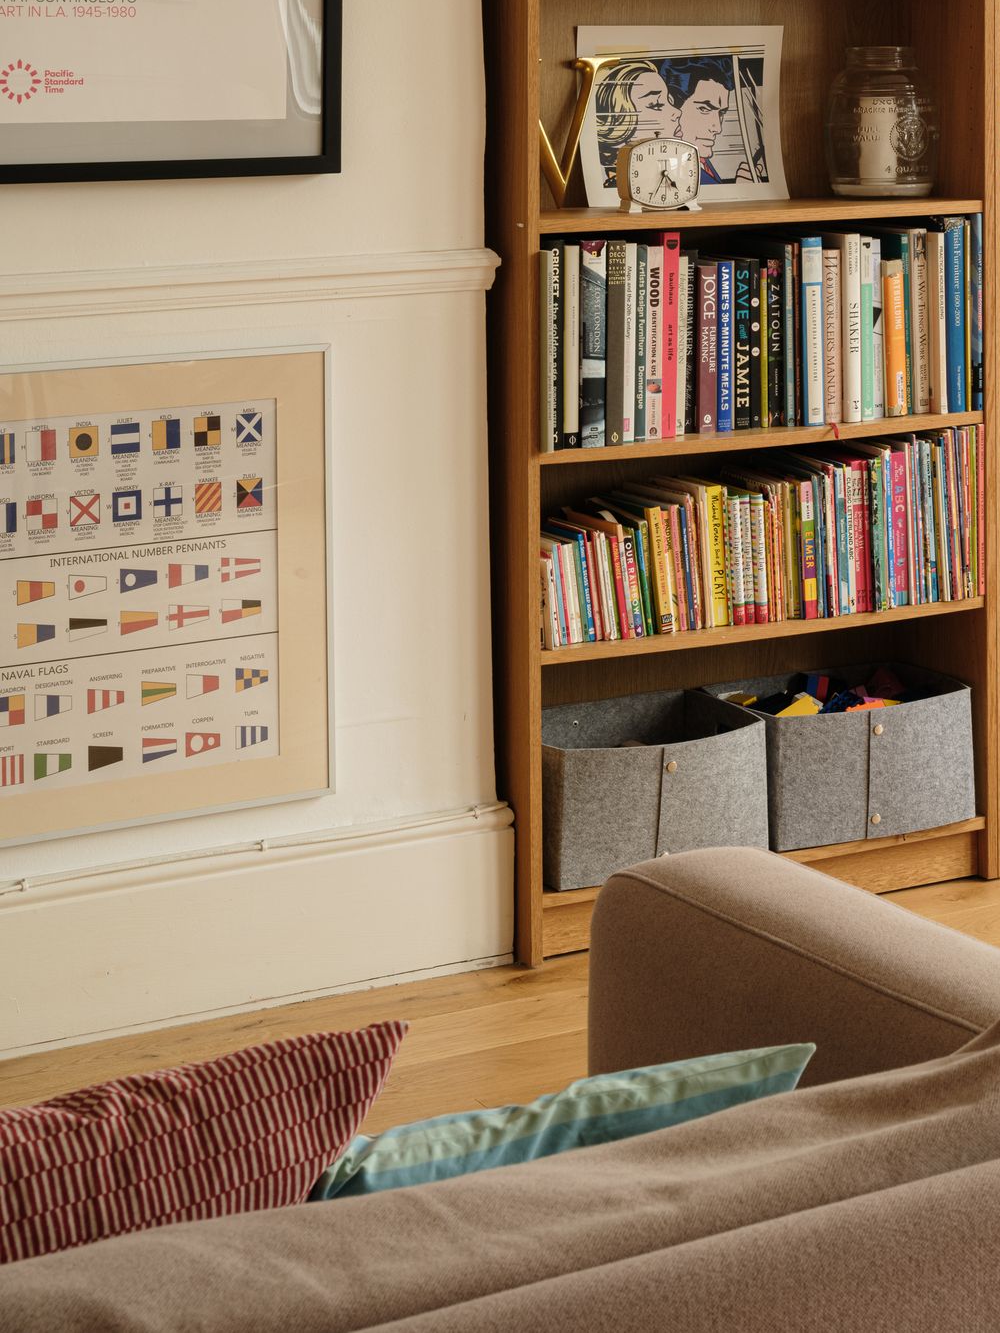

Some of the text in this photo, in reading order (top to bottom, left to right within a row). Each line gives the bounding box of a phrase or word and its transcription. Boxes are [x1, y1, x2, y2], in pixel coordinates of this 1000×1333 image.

[0, 6, 24, 17] ART
[28, 6, 41, 17] IN
[72, 6, 137, 18] 1945-1980
[44, 70, 74, 78] Pacific
[44, 77, 84, 86] Standard
[44, 86, 64, 94] Time
[660, 144, 668, 153] 12
[636, 153, 644, 162] 10
[687, 153, 692, 162] 2
[633, 170, 639, 178] 9
[635, 186, 641, 194] 8
[648, 192, 654, 200] 7
[660, 194, 667, 202] 6
[674, 192, 679, 200] 5
[551, 248, 560, 298] CRICKET
[649, 266, 660, 308] WOOD
[701, 274, 716, 320] JOYCE
[685, 262, 695, 356] THE GLOBEMAKERS
[917, 262, 926, 361] THE WAY THINGS WORK
[593, 288, 601, 353] LOST LONDON
[771, 284, 780, 352] ZAITOUN
[824, 255, 838, 408] WOODWORKER'S MANUAL
[848, 302, 859, 354] SHAKER
[636, 261, 646, 410] Artists Design Furniture Domergue
[721, 266, 730, 411] JAMIE'S 30-MINUTE MEALS
[736, 269, 750, 408] SAVE JAMIE
[701, 326, 709, 363] MAKING
[708, 326, 716, 373] FURNITURE
[27, 493, 55, 501] UNIFORM
[711, 495, 726, 601] Michael Rosen's PLAY!
[804, 530, 815, 569] ELMER
[49, 540, 227, 568] INTERNATIONAL NUMBER PENNANTS
[625, 542, 640, 615] OUR RAINBOW
[185, 657, 227, 669] INTERROGATIVE
[239, 653, 265, 662] NEGATIVE
[1, 664, 69, 681] NAVAL FLAGS
[141, 665, 176, 675] PREPARATIVE
[89, 673, 123, 682] ANSWERING
[34, 679, 73, 690] DESIGNATION
[192, 716, 214, 725] CORPEN
[141, 722, 175, 732] FORMATION
[92, 730, 114, 739] SCREEN
[36, 737, 70, 747] STARBOARD
[0, 745, 15, 753] PORT
